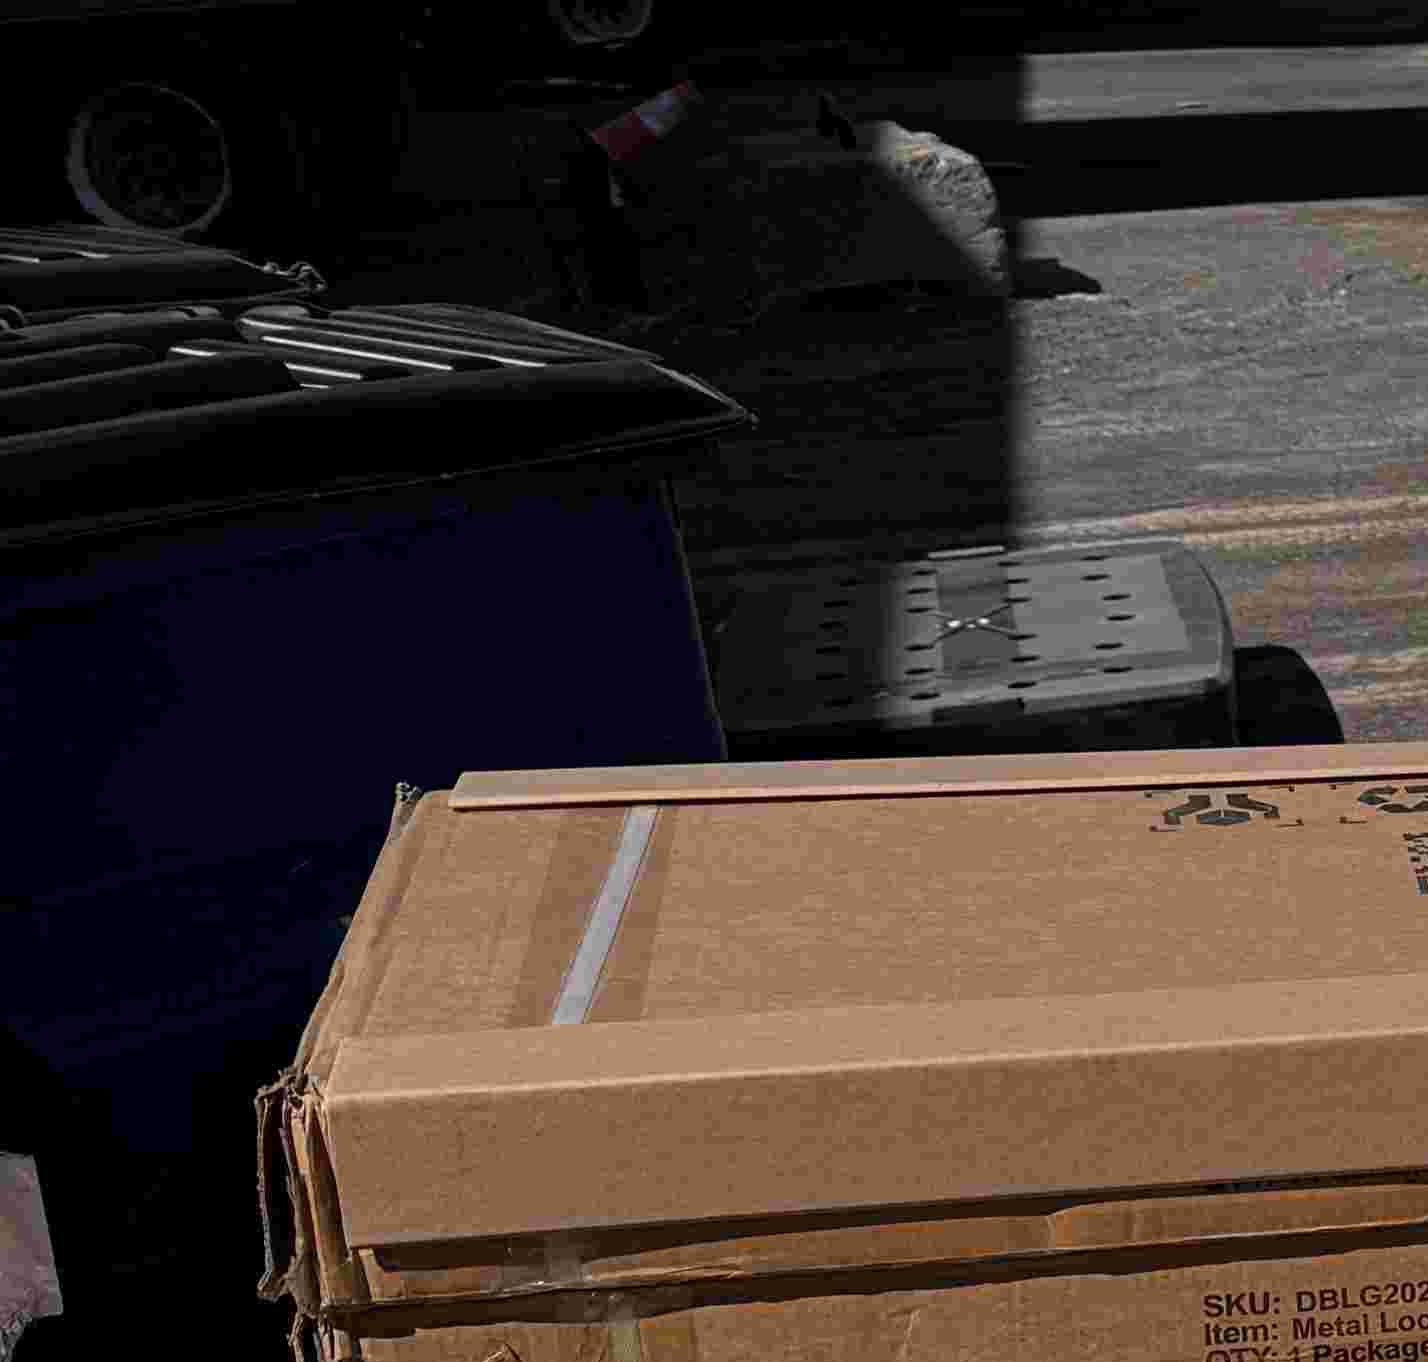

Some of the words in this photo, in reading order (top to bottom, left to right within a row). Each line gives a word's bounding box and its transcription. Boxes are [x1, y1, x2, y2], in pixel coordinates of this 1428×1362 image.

[1203, 1291, 1280, 1318] SKU:
[1205, 1320, 1279, 1347] Item:
[1292, 1312, 1370, 1341] Metal
